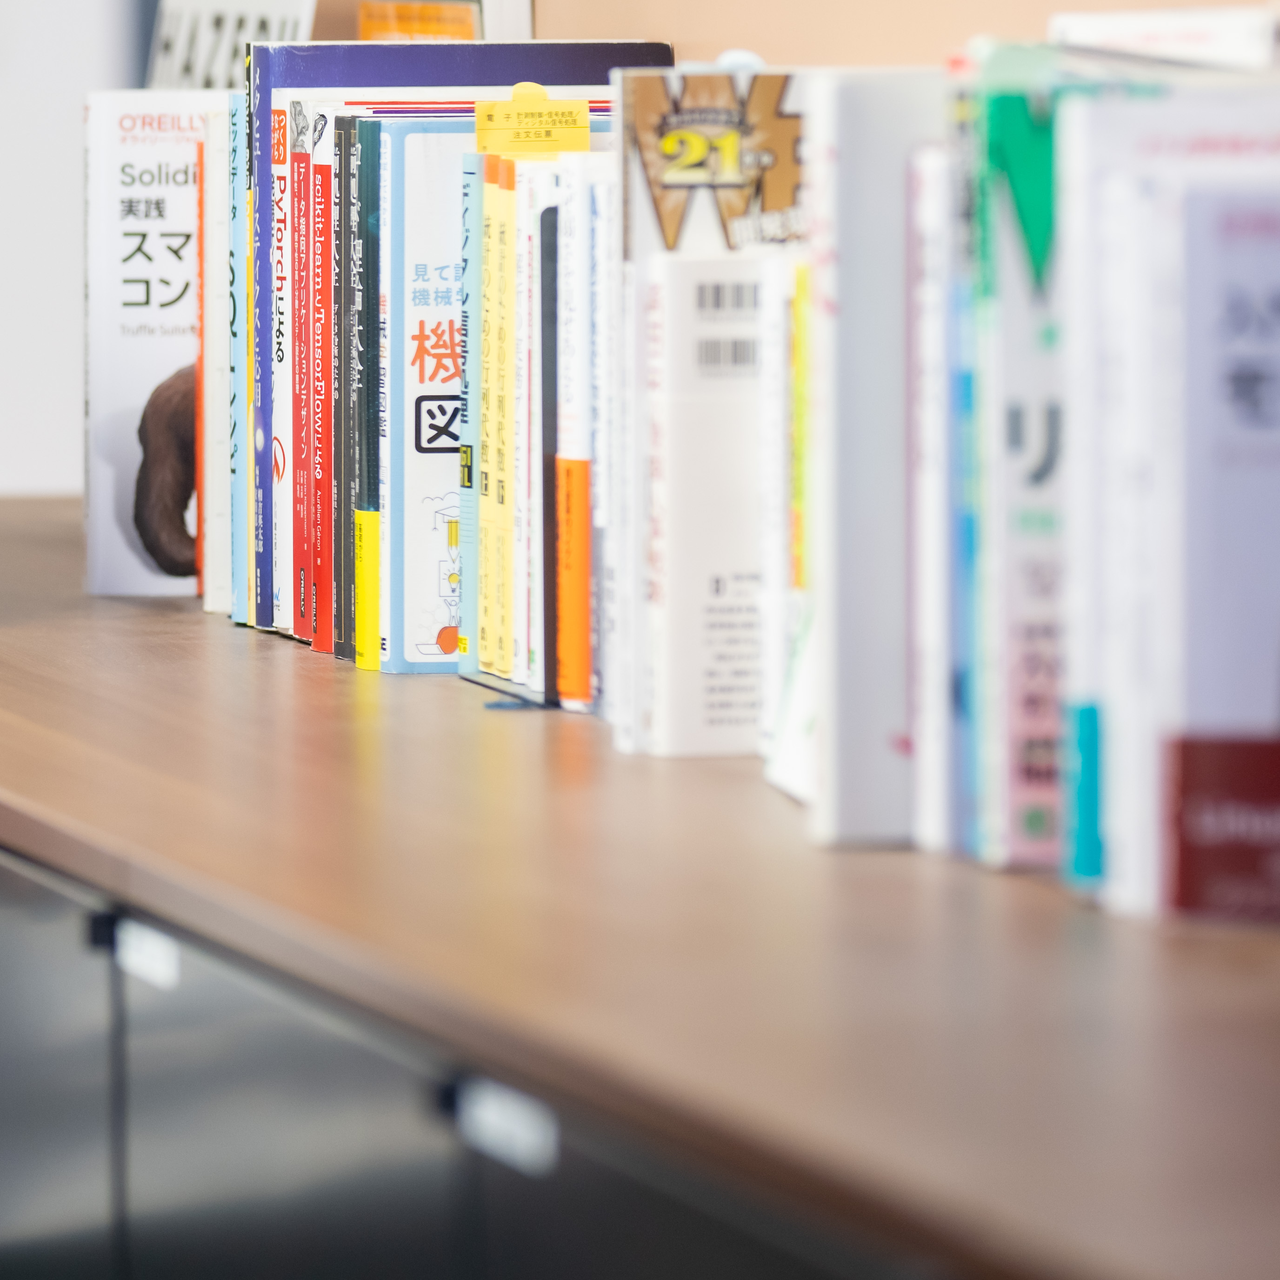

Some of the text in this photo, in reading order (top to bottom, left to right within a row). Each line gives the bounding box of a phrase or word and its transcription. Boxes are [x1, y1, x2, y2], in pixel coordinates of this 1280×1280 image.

[120, 198, 166, 220] 実践
[121, 231, 194, 263] スマ
[121, 277, 191, 308] コン
[410, 319, 462, 385] 機
